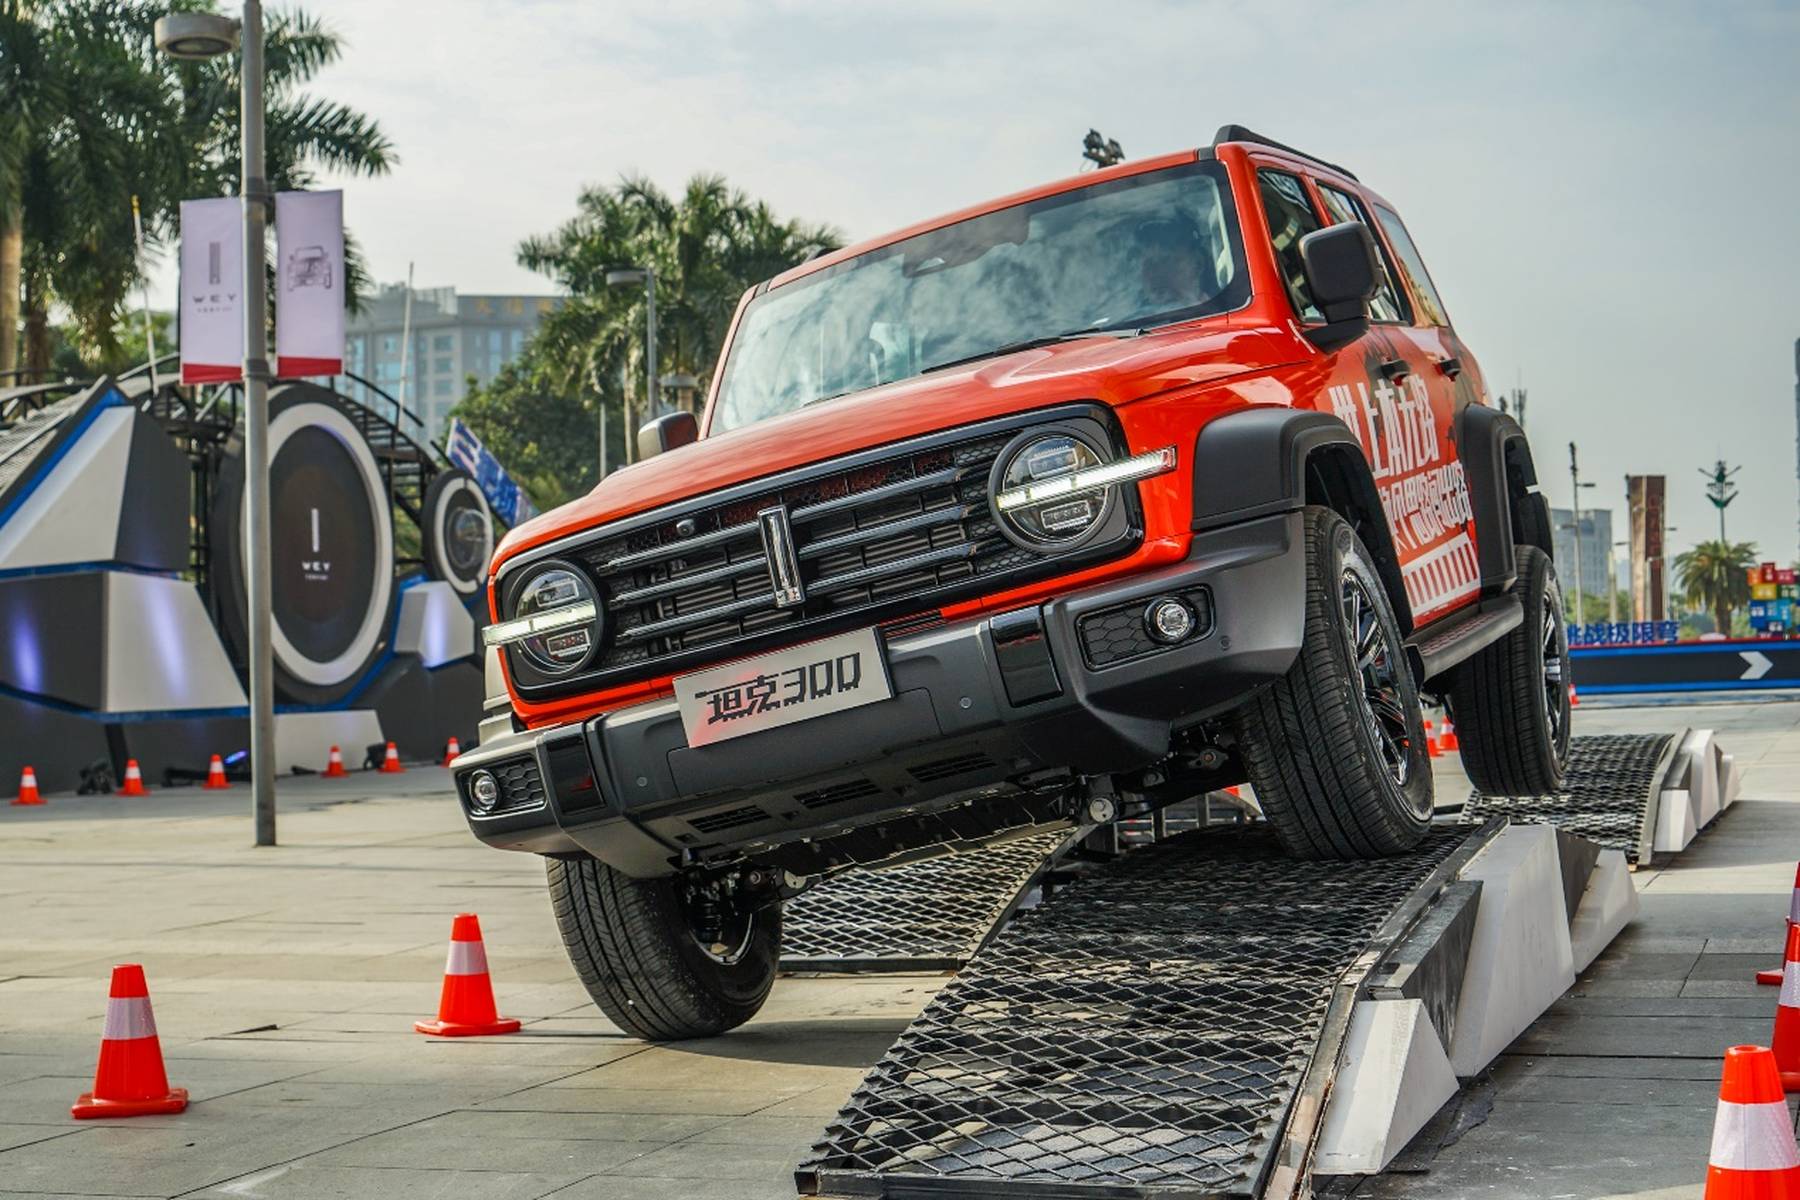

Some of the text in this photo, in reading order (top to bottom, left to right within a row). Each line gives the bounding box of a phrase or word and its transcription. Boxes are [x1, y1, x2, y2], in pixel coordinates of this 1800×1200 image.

[192, 293, 237, 303] WEY
[302, 561, 330, 572] WEY
[696, 652, 861, 725] 坦克300
